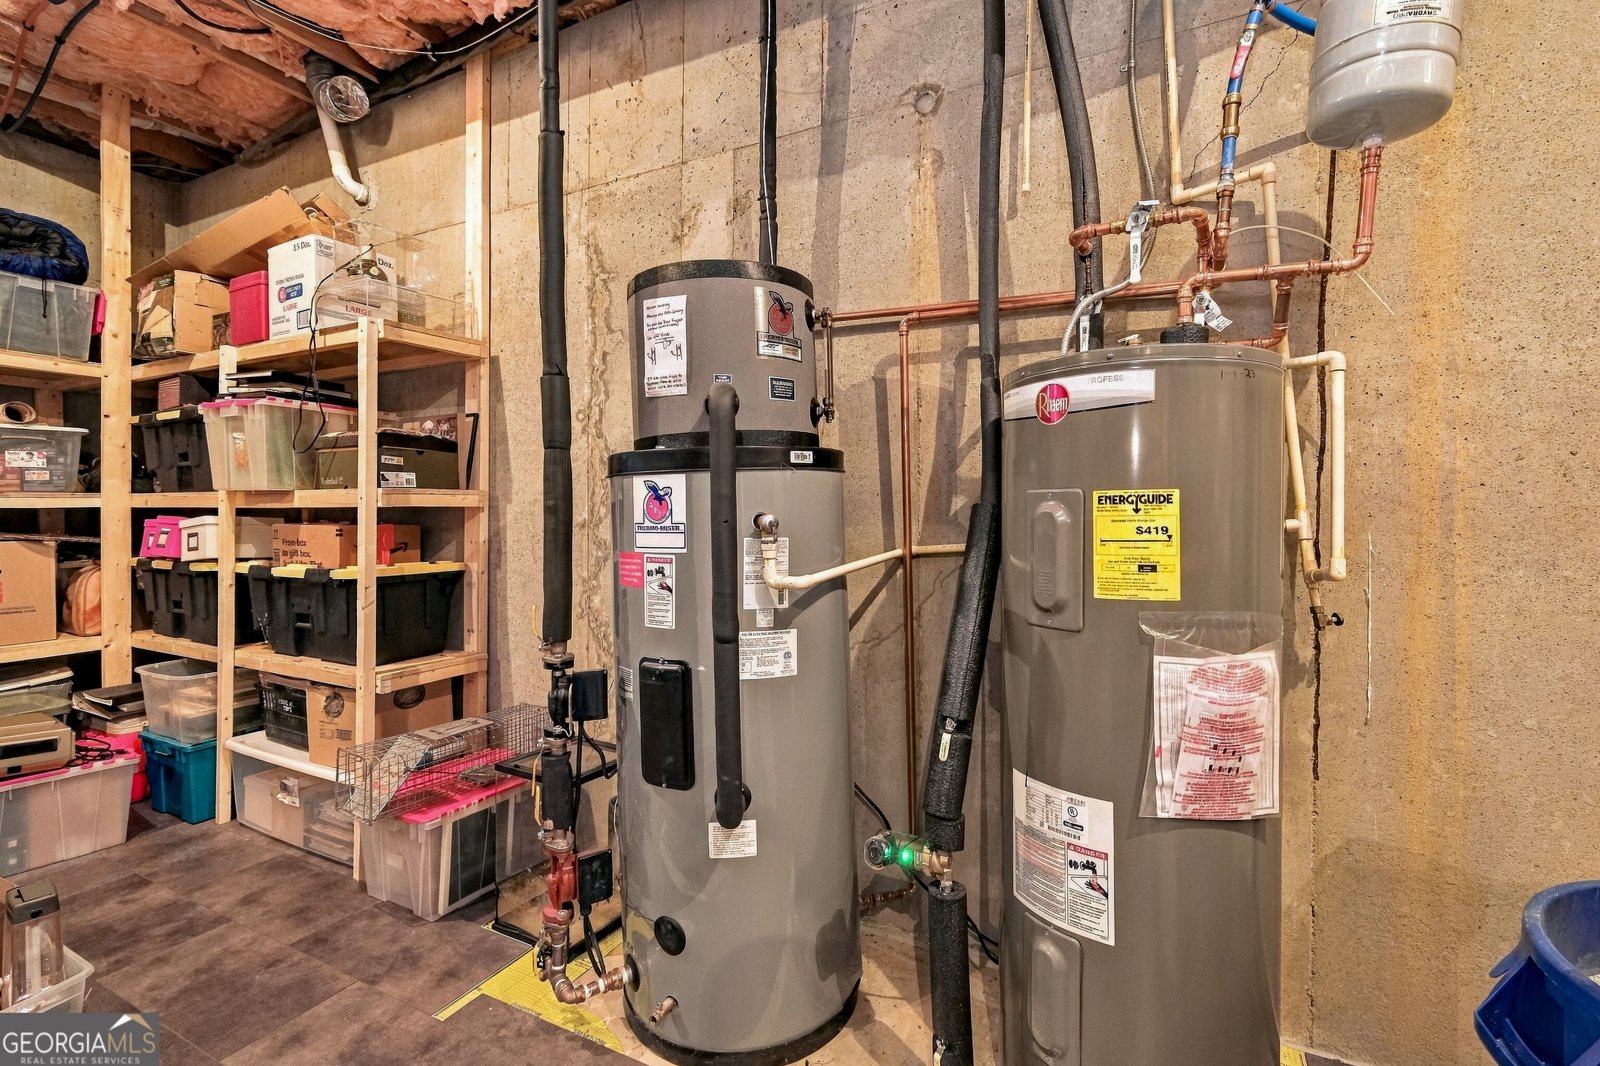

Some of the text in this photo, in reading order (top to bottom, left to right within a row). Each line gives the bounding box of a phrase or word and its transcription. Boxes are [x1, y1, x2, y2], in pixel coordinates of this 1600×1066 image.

[378, 258, 394, 269] Doz.
[345, 305, 372, 316] LARGE
[1039, 385, 1069, 417] Rheem
[1136, 526, 1169, 535] $419
[1076, 847, 1106, 860] DANGER
